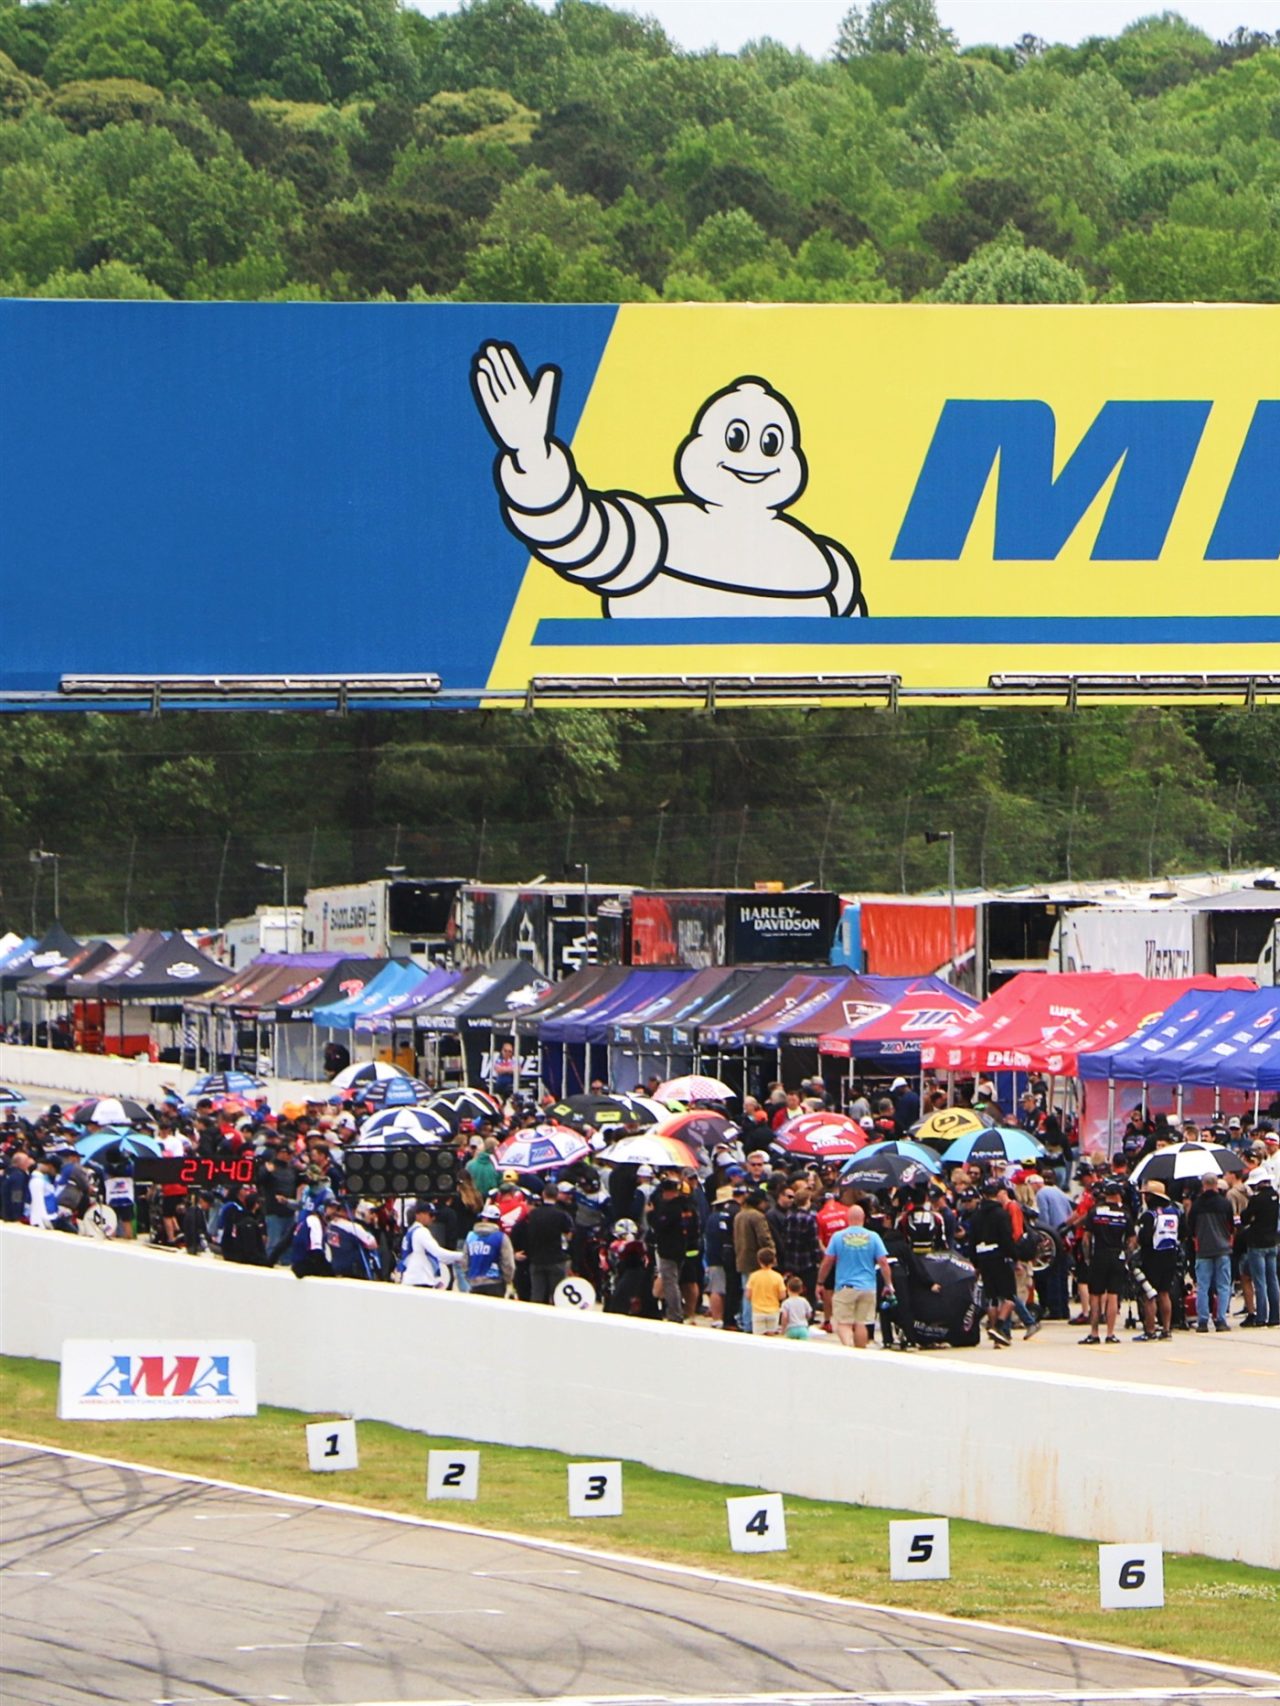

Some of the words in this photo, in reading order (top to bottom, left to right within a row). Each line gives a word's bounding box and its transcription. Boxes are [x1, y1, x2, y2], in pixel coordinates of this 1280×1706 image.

[740, 906, 801, 923] HARLEY-
[754, 918, 820, 931] DAVIDSON
[563, 1284, 582, 1305] 8
[82, 1355, 236, 1398] AMA
[325, 1435, 339, 1456] 1
[443, 1464, 465, 1485] 2
[585, 1476, 607, 1500] 3
[746, 1510, 768, 1535] 4
[908, 1535, 933, 1562] 5
[1119, 1560, 1145, 1589] 6
